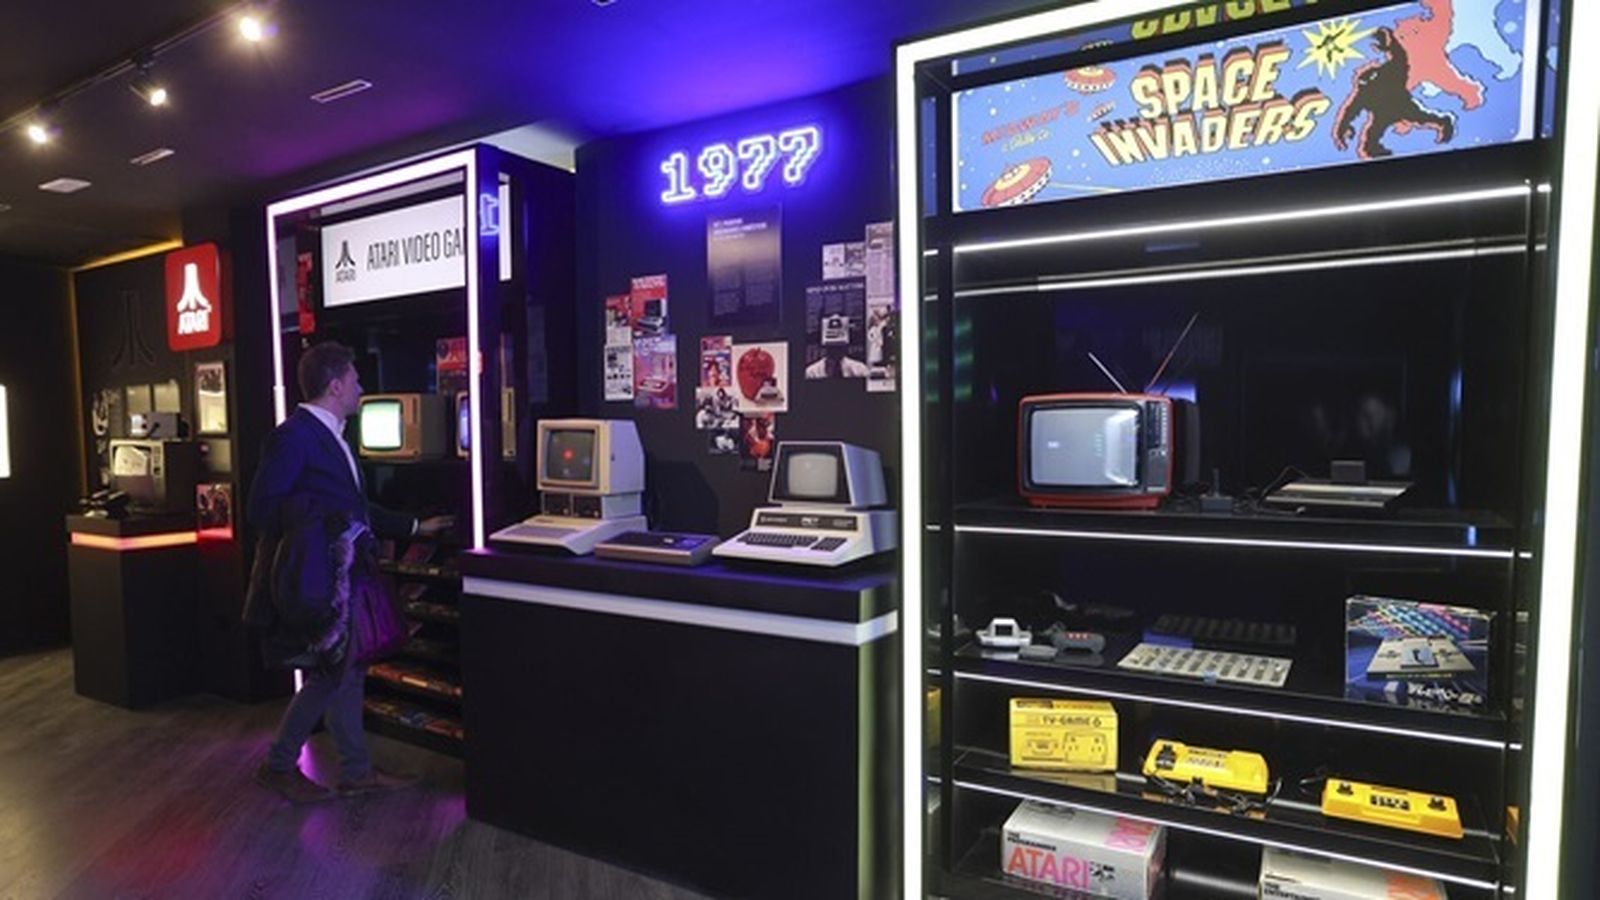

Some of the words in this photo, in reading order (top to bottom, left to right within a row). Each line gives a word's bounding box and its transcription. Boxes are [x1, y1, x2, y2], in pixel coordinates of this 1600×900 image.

[1131, 42, 1290, 119] SPACE
[1089, 90, 1331, 166] INVADERS
[660, 126, 818, 203] 1977
[367, 241, 400, 272] ATARI
[402, 231, 440, 266] VIDEO
[178, 309, 209, 335] ATARI
[1007, 846, 1089, 890] ATARI
